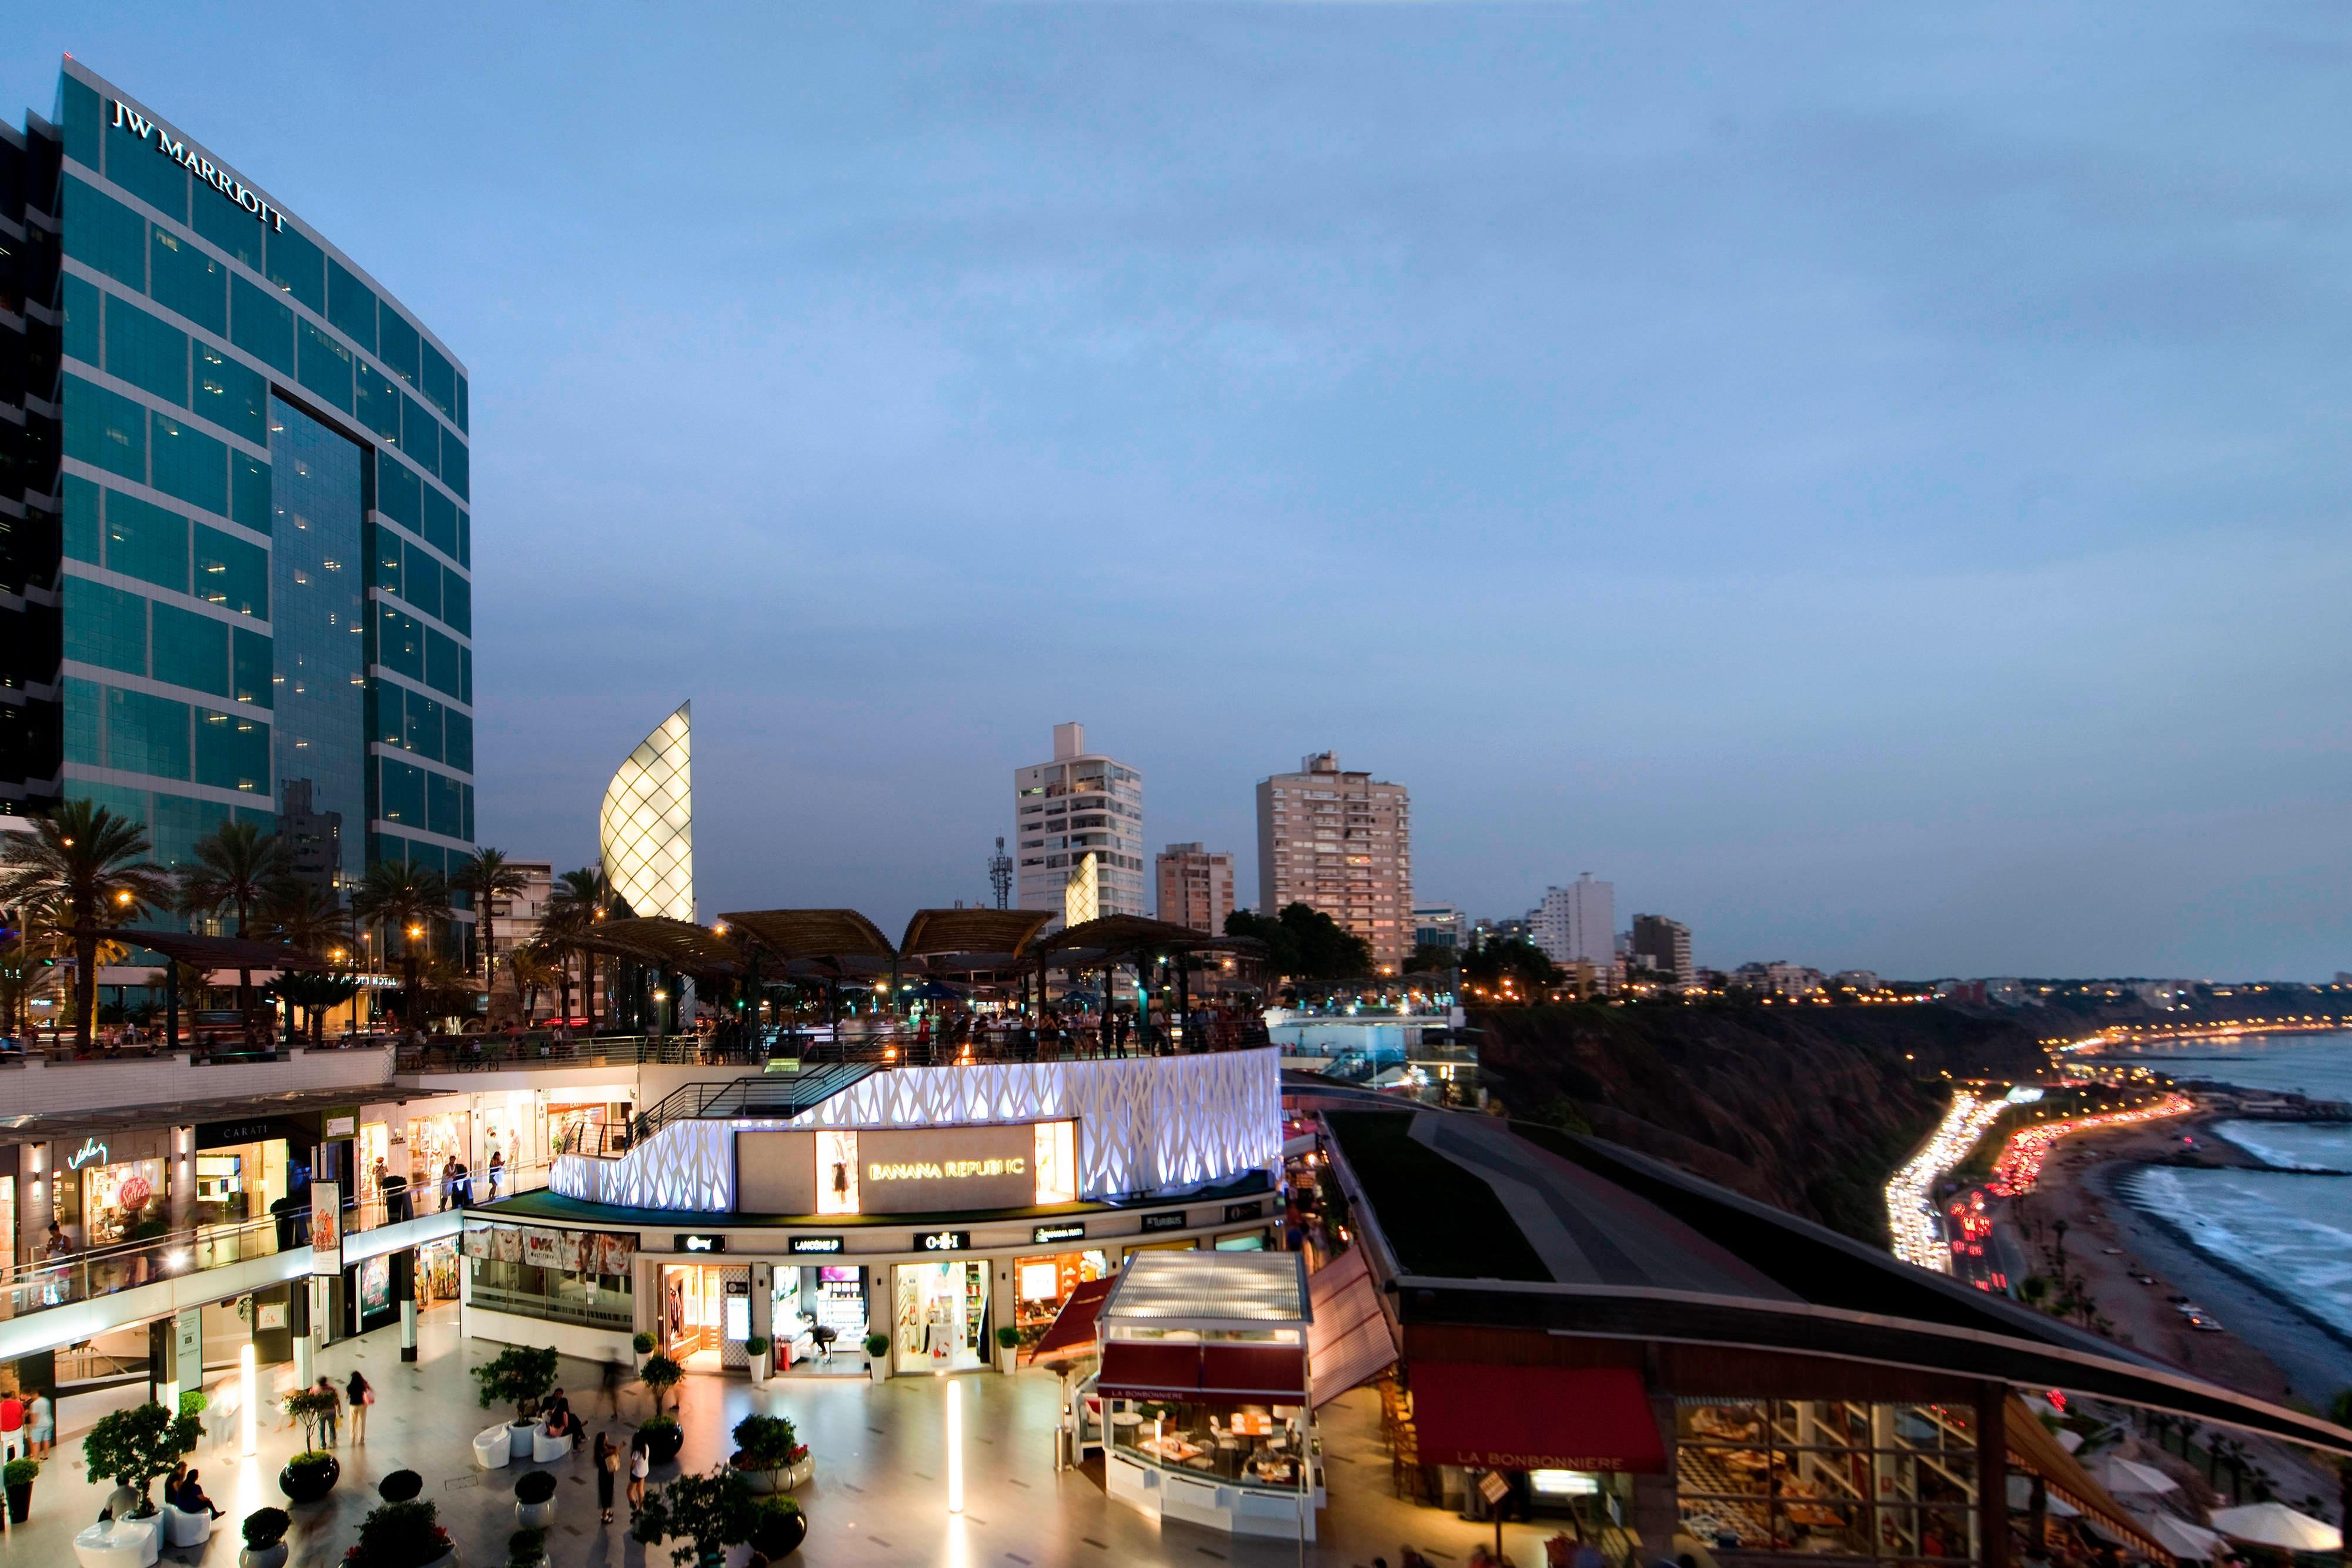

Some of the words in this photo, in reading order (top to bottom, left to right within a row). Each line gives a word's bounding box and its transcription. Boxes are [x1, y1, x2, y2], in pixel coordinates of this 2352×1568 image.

[112, 99, 155, 139] JW
[158, 128, 287, 234] MARRIOTT
[223, 1124, 266, 1138] CARATI
[870, 1162, 942, 1181] BANANA
[946, 1158, 1025, 1178] REPUBLIC
[530, 1236, 553, 1252] UVK
[1457, 1451, 1480, 1463] LA
[1488, 1452, 1623, 1469] BONBONNIERE
